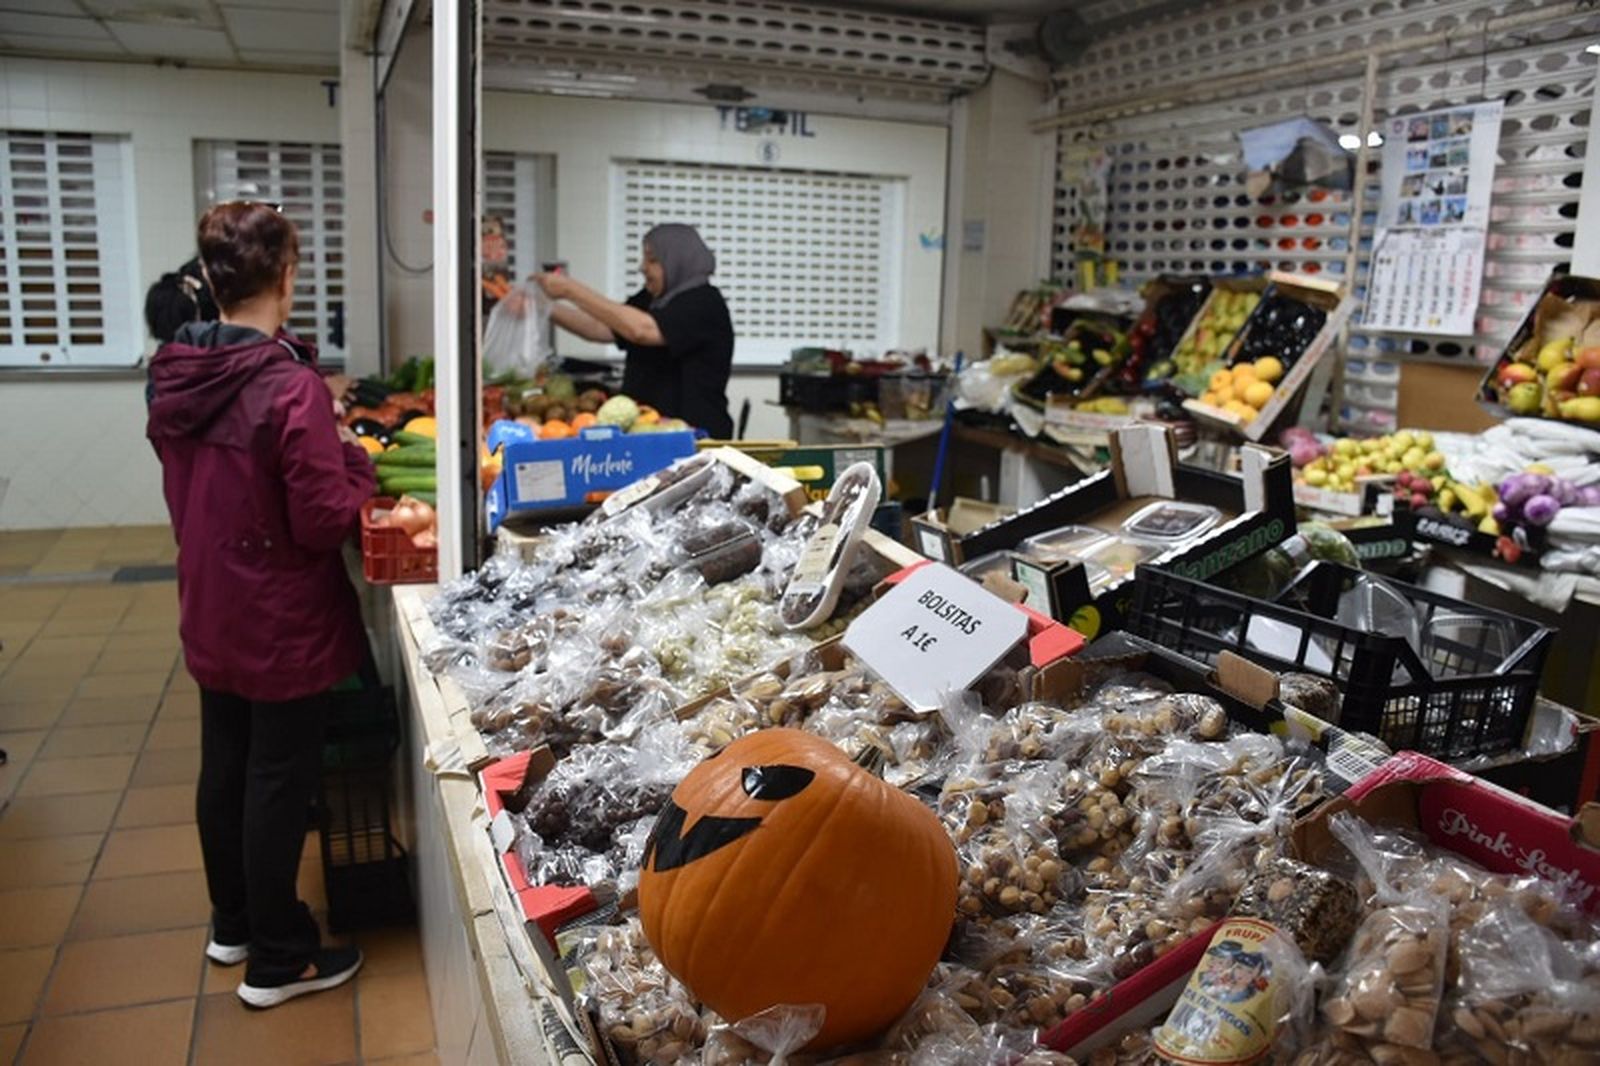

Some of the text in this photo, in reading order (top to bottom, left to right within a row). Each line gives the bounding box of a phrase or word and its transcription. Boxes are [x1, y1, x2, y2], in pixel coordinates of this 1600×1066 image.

[917, 589, 982, 635] BOLSITAS
[901, 625, 938, 652] A 1€
[1438, 808, 1514, 858] Pink
